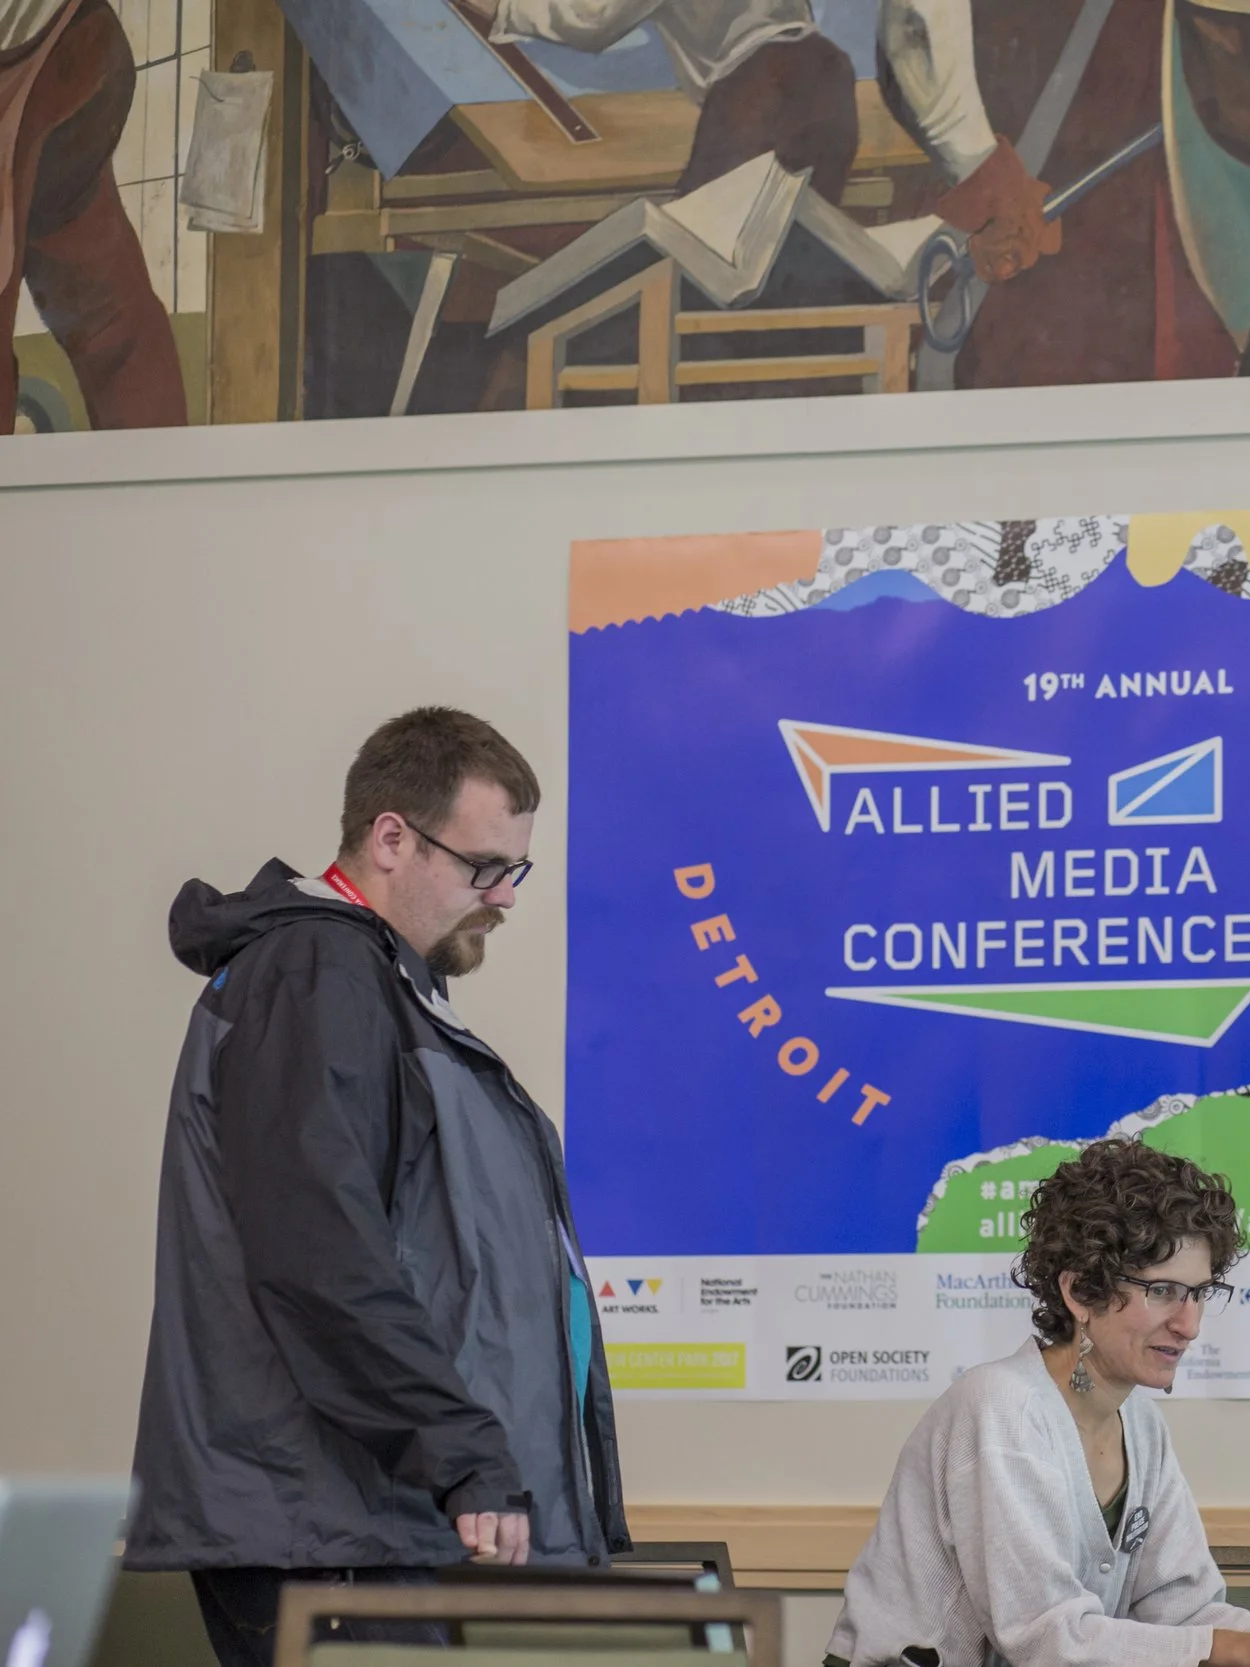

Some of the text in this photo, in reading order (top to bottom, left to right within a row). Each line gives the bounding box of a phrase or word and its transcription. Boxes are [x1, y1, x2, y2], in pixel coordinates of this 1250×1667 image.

[1023, 668, 1234, 701] 19TH ANNUAL
[844, 781, 1073, 835] ALLIED
[1010, 846, 1218, 899] MEDIA
[673, 862, 892, 1127] DETROIT
[701, 1278, 743, 1287] National
[834, 1269, 897, 1285] NATHAN
[936, 1273, 1012, 1291] MacArth
[701, 1288, 758, 1297] Endowment
[794, 1284, 898, 1304] CUMMINGS
[733, 1297, 751, 1306] Arts
[827, 1302, 897, 1311] FOUNDATION
[936, 1292, 1031, 1310] Foundation
[602, 1305, 619, 1314] ART
[830, 1349, 930, 1365] OPEN SOCIETY
[1200, 1343, 1221, 1356] The
[831, 1367, 930, 1383] FOUNDATIONS
